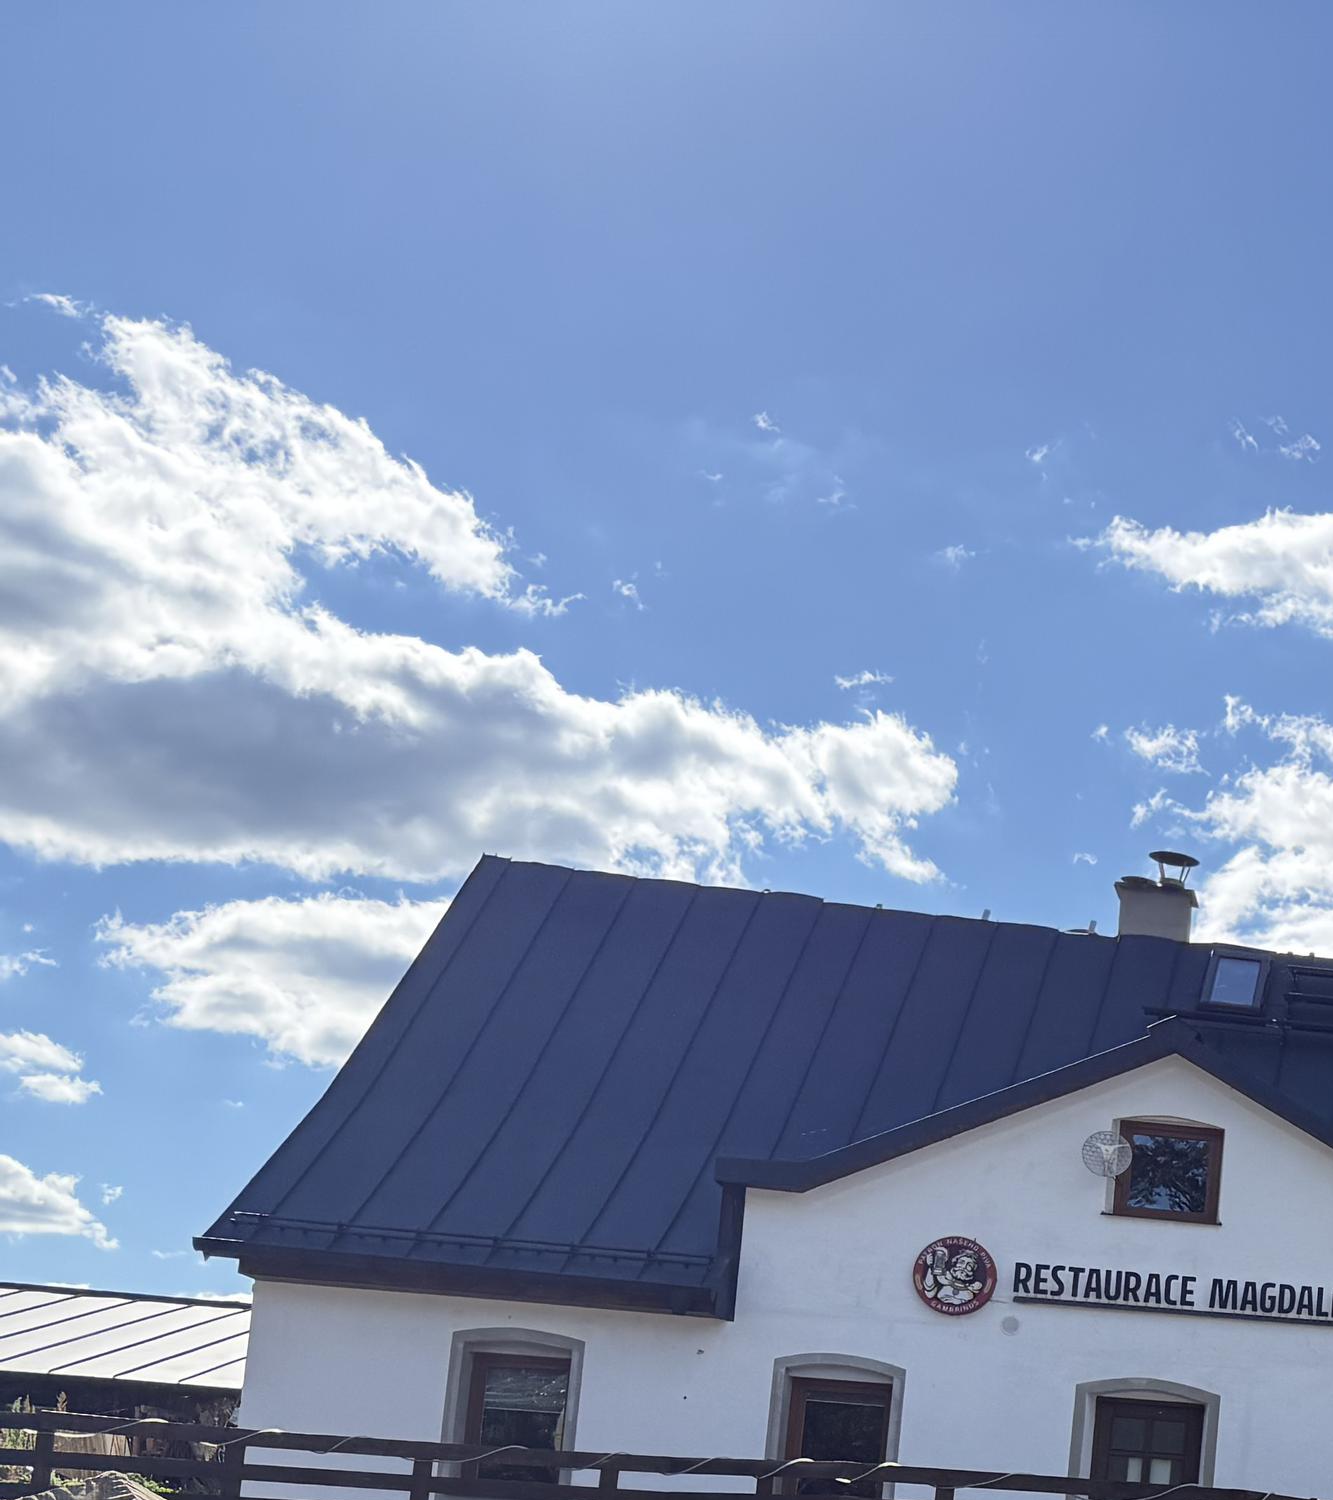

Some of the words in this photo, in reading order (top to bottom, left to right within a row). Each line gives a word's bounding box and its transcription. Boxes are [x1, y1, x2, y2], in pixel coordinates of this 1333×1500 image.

[980, 1252, 993, 1269] PIVA
[1013, 1261, 1197, 1307] RESTAURACE
[930, 1300, 980, 1313] GAMBRINUS
